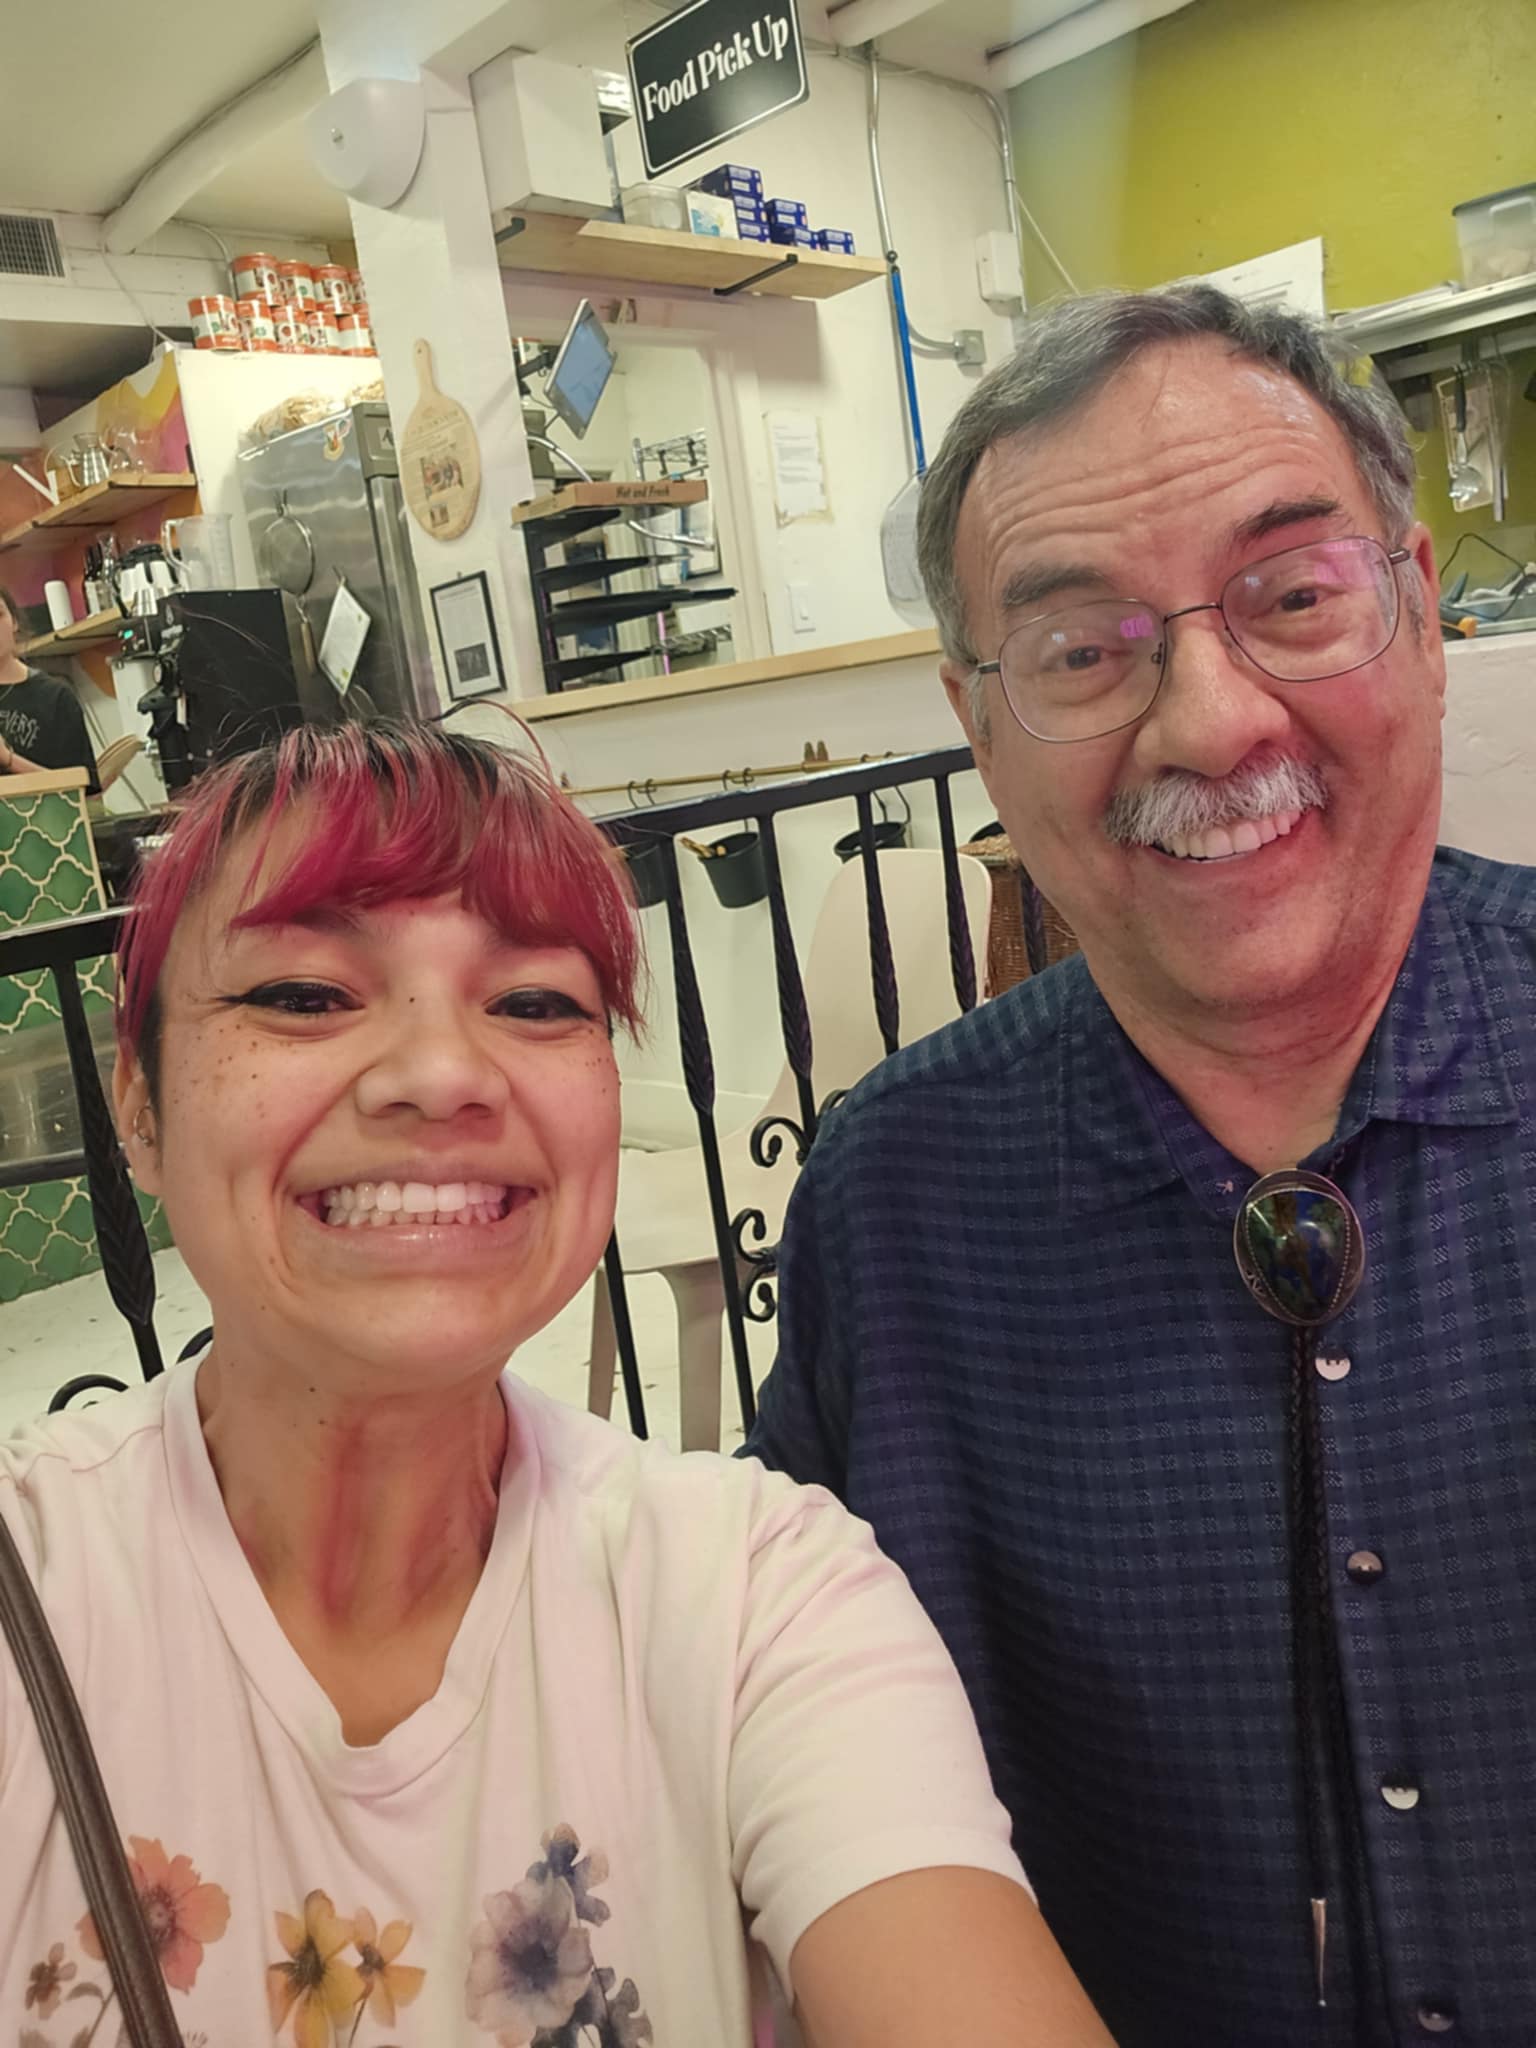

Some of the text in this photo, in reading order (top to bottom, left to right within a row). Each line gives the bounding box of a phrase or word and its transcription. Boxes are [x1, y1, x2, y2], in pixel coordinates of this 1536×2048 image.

[642, 13, 789, 122] Food Pick Up
